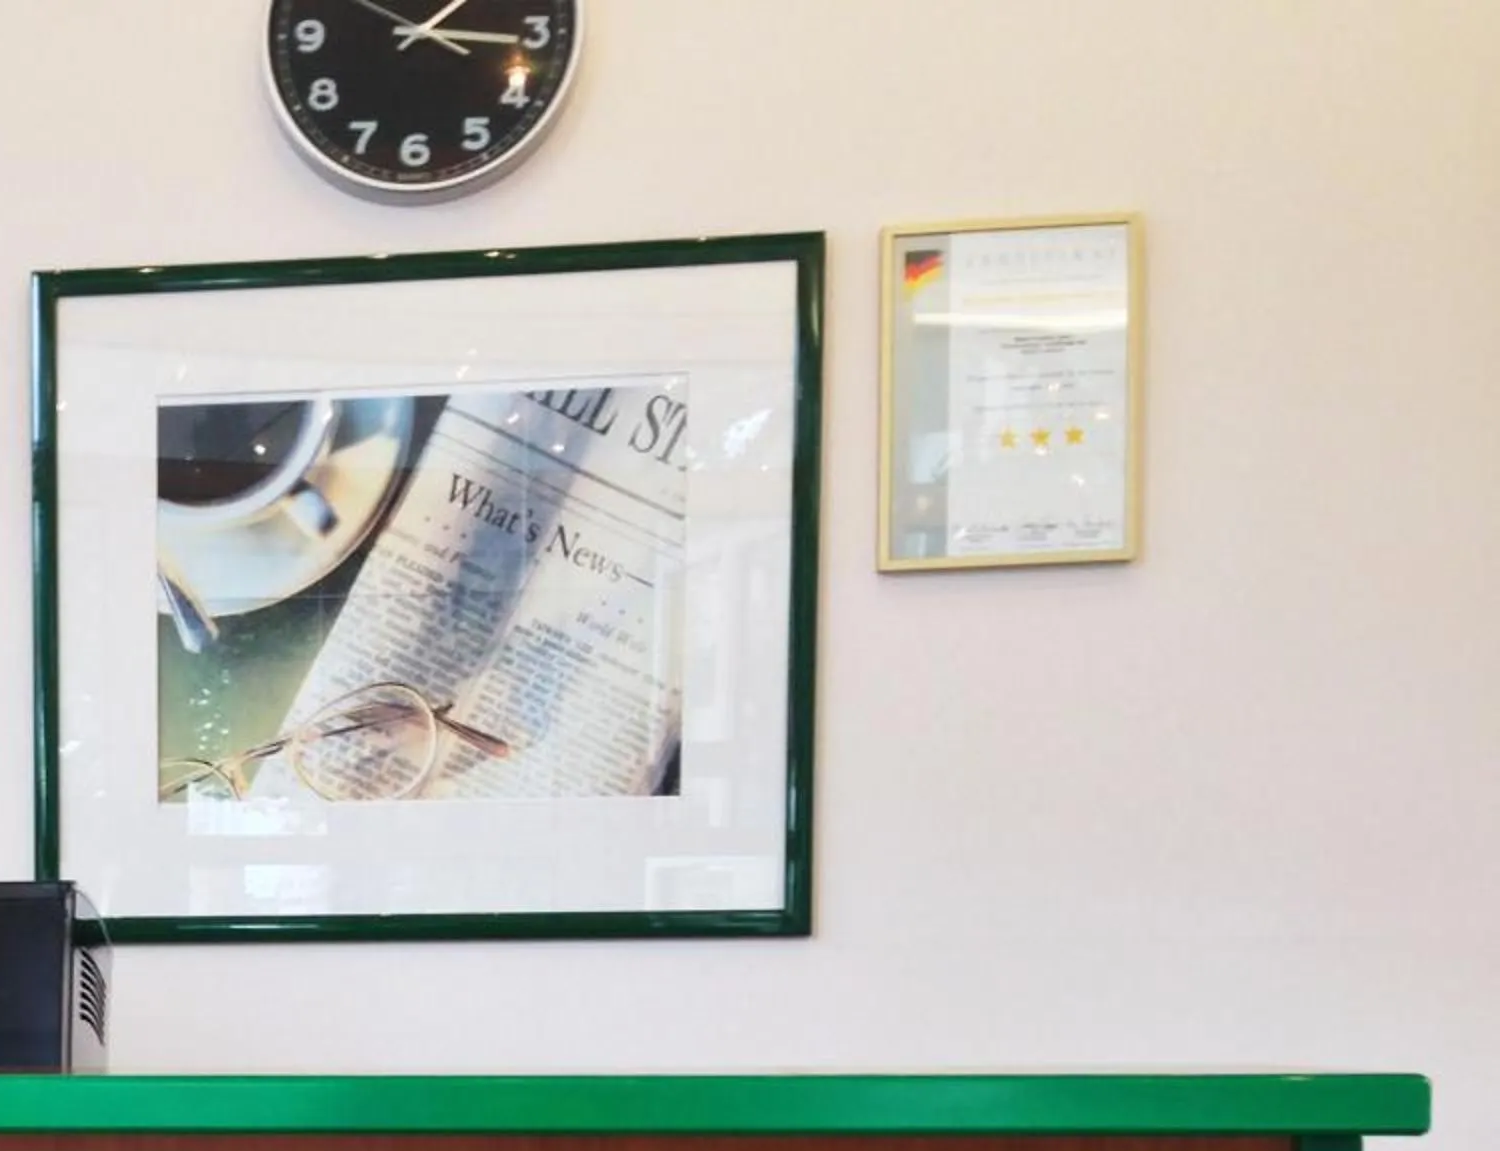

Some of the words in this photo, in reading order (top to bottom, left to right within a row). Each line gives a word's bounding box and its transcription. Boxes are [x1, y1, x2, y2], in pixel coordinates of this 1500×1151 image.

[294, 18, 326, 53] 9
[522, 15, 551, 49] 3
[308, 78, 339, 111] 8
[501, 74, 529, 108] 4
[349, 120, 378, 155] 7
[399, 133, 431, 167] 6
[461, 116, 491, 151] 5
[447, 473, 542, 544] What's
[544, 524, 624, 582] News
